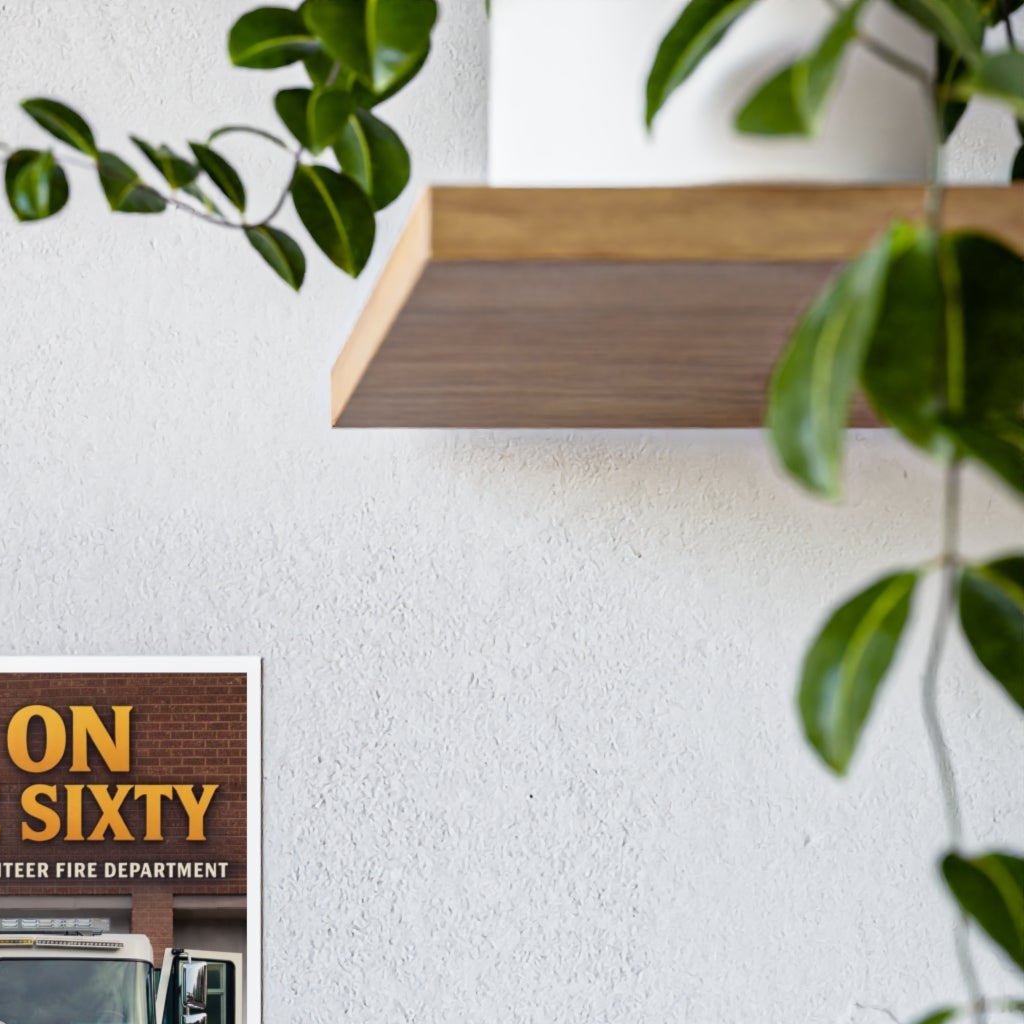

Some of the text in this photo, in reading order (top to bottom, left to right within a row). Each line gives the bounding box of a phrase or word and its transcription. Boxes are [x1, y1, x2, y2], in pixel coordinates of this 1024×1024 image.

[7, 704, 133, 773] ON
[21, 784, 219, 842] SIXTY
[56, 861, 98, 879] FIRE
[104, 861, 229, 879] DEPARTMENT
